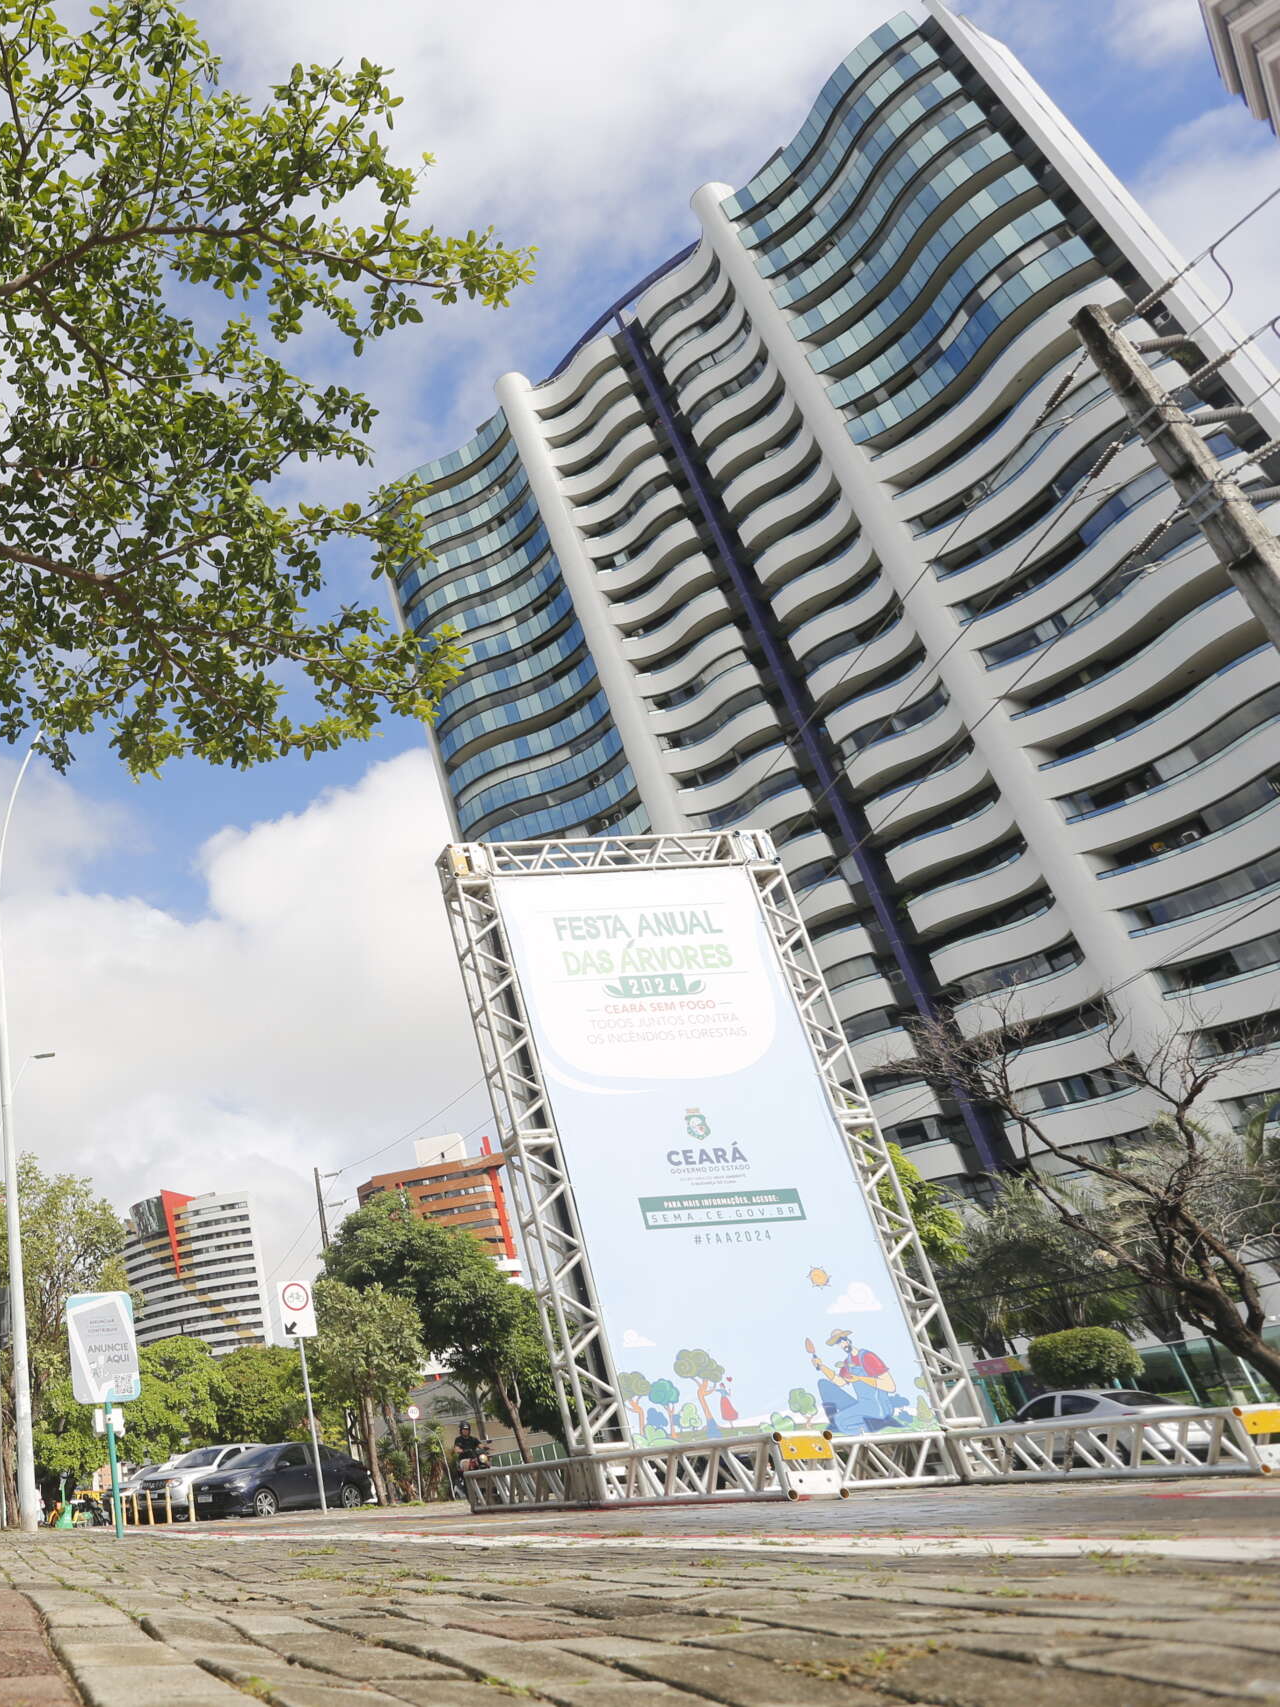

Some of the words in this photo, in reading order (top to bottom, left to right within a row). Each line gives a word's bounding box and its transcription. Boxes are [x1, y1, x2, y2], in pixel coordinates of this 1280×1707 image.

[553, 914, 632, 941] FESTA
[638, 910, 723, 937] ANUAL
[561, 950, 615, 976] DAS
[620, 939, 734, 973] ÁRVORES
[628, 977, 679, 995] 2024
[604, 1001, 646, 1014] CEARÁ
[650, 1001, 676, 1013] SEM
[679, 999, 716, 1010] FOGO
[588, 1018, 633, 1030] TODOS
[637, 1015, 685, 1028] JUNTOS
[688, 1012, 740, 1025] CONTRA
[586, 1034, 605, 1045] OS
[607, 1028, 676, 1043] INCÊNDIOS
[667, 1141, 748, 1166] CEARÁ
[670, 1167, 707, 1175] GOVERNO
[663, 1201, 682, 1209] PARA
[682, 1200, 700, 1208] MAIS
[694, 1230, 772, 1245] #FAA2024
[87, 1343, 129, 1353] ANUNCIE
[106, 1355, 130, 1364] AQUI
